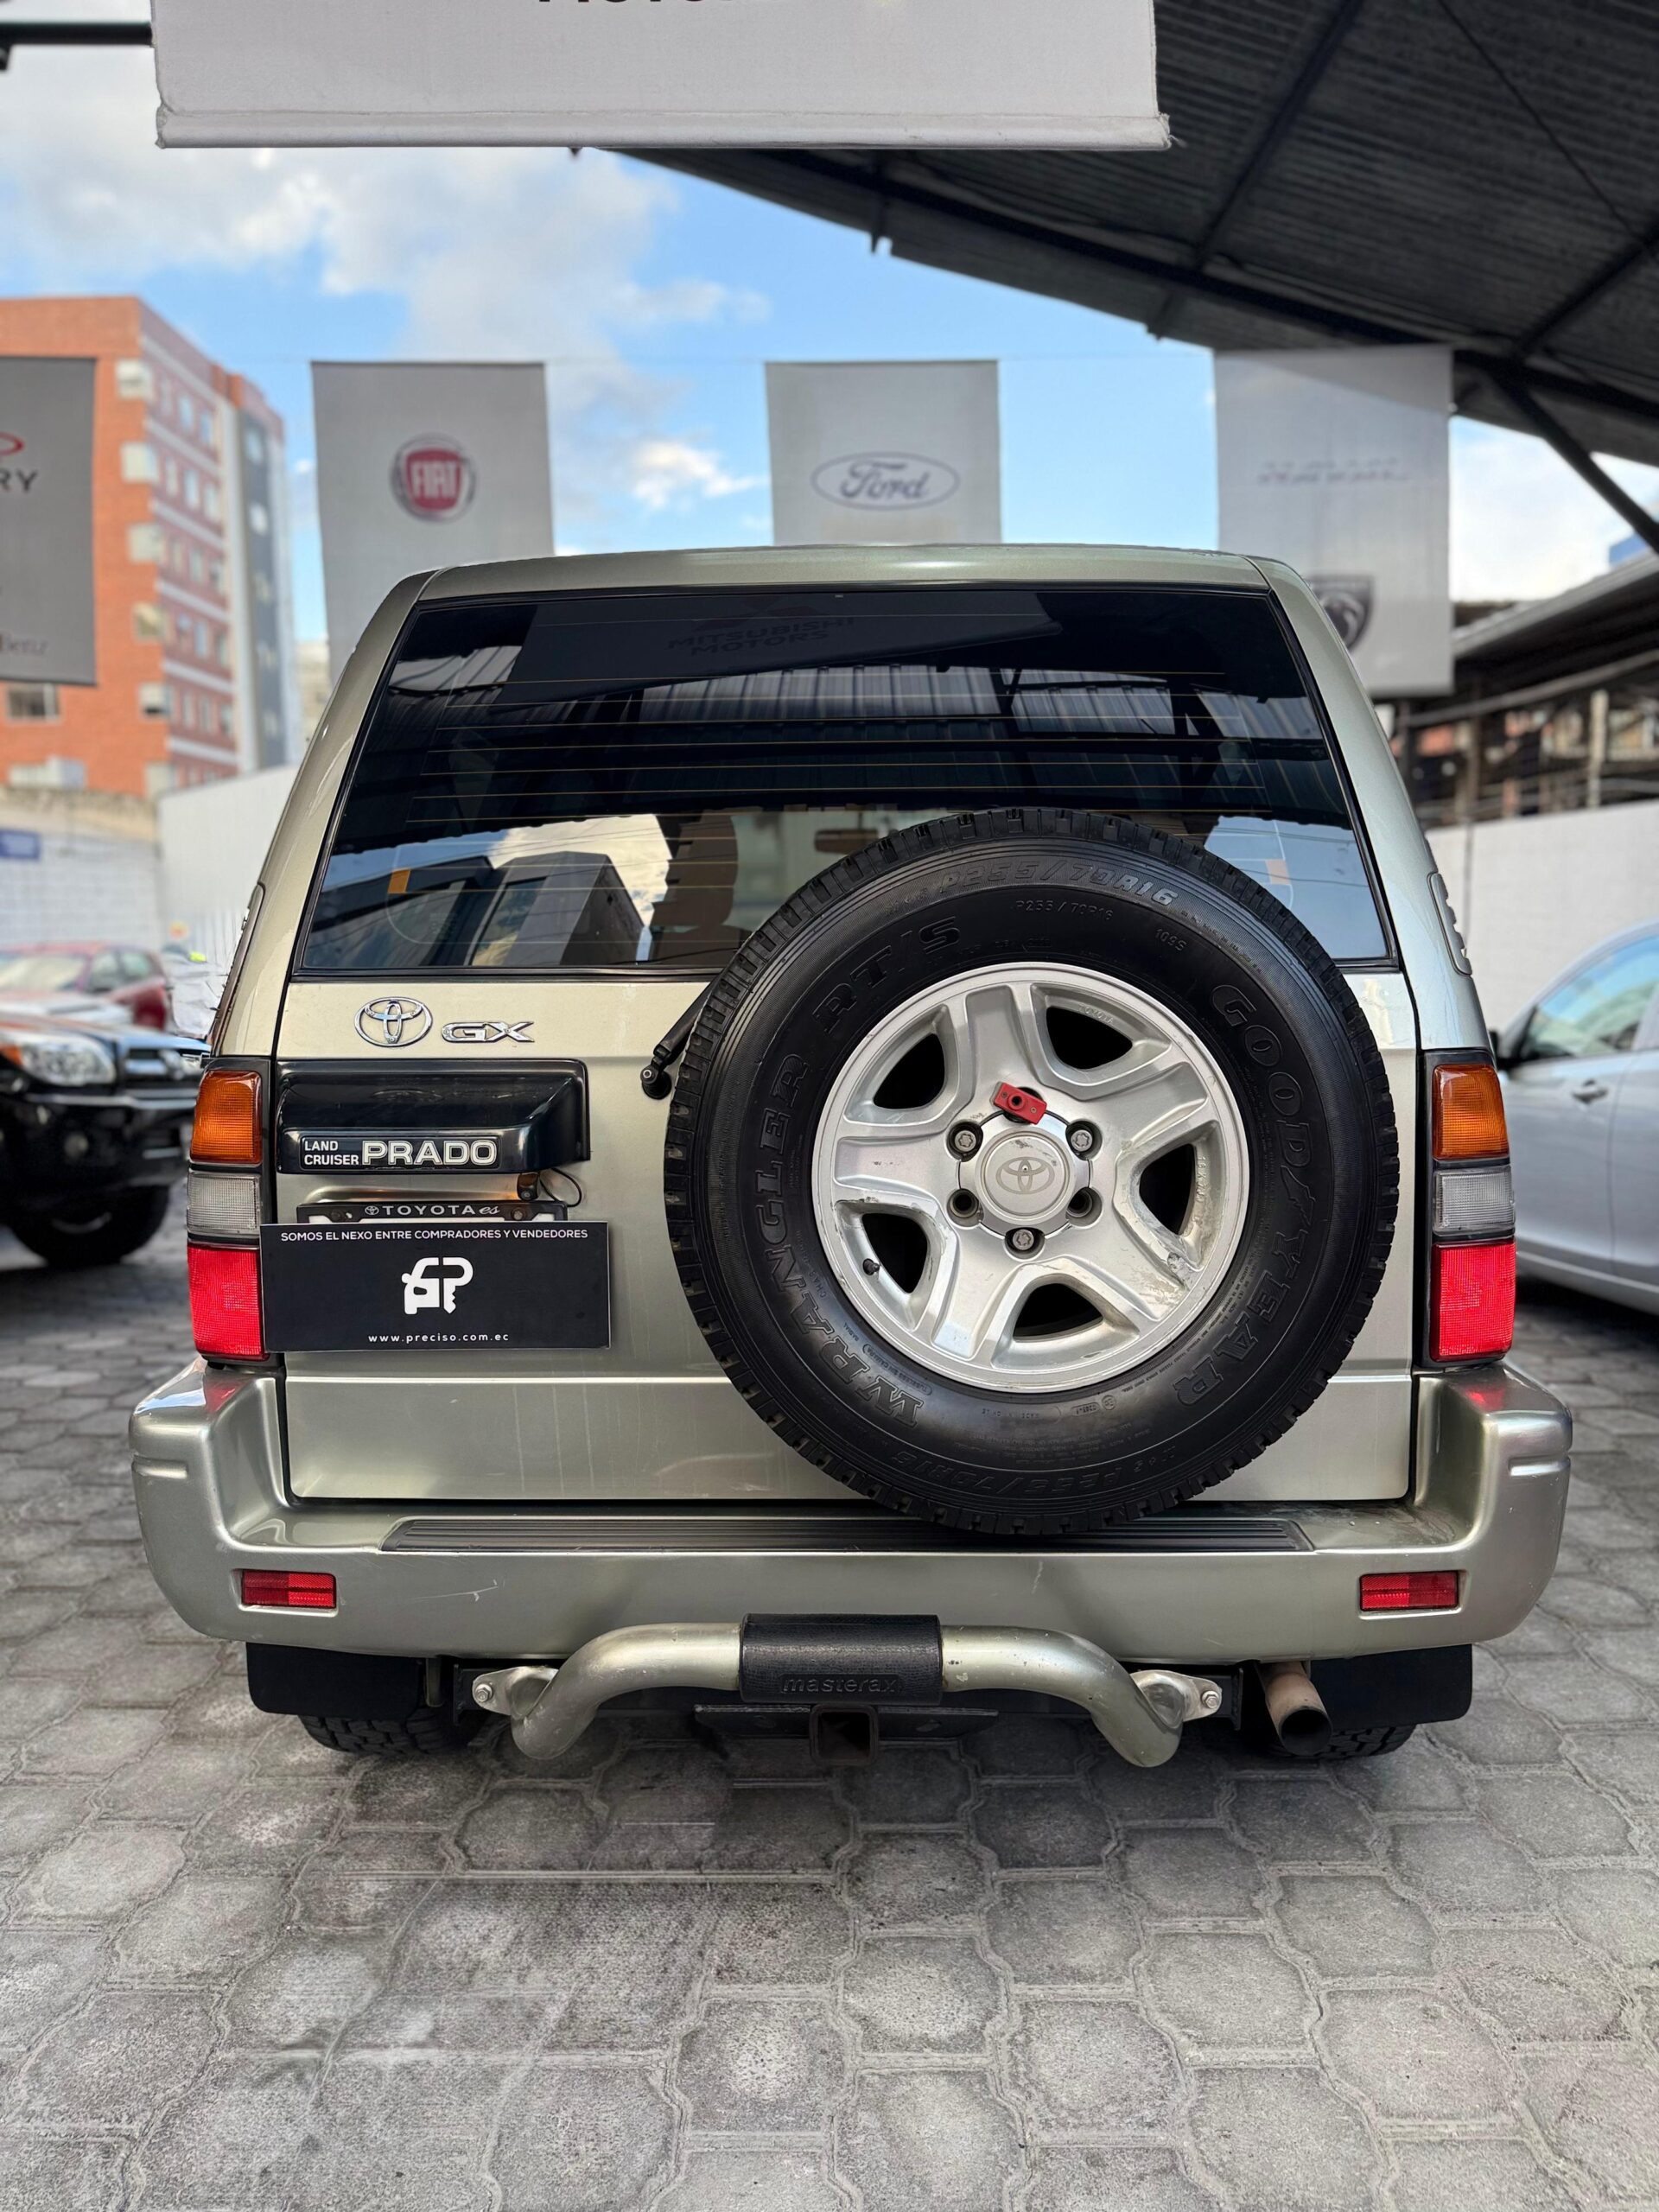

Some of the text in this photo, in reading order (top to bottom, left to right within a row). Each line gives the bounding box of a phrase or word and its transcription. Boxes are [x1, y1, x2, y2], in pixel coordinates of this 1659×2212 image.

[410, 461, 457, 499] FIAT
[839, 461, 930, 499] Ford
[691, 630, 830, 657] MOTORS
[442, 1021, 535, 1043] GX
[303, 1140, 498, 1166] CRUISER PRADO
[304, 1141, 338, 1152] LAND
[383, 1205, 475, 1216] TOYOTA
[281, 1229, 588, 1242] SOMOS EL NEXO ENTRE COMPRADORES Y VENDEDORES
[368, 1332, 509, 1344] www.preciso.com.ec
[782, 1677, 897, 1693] masterax
